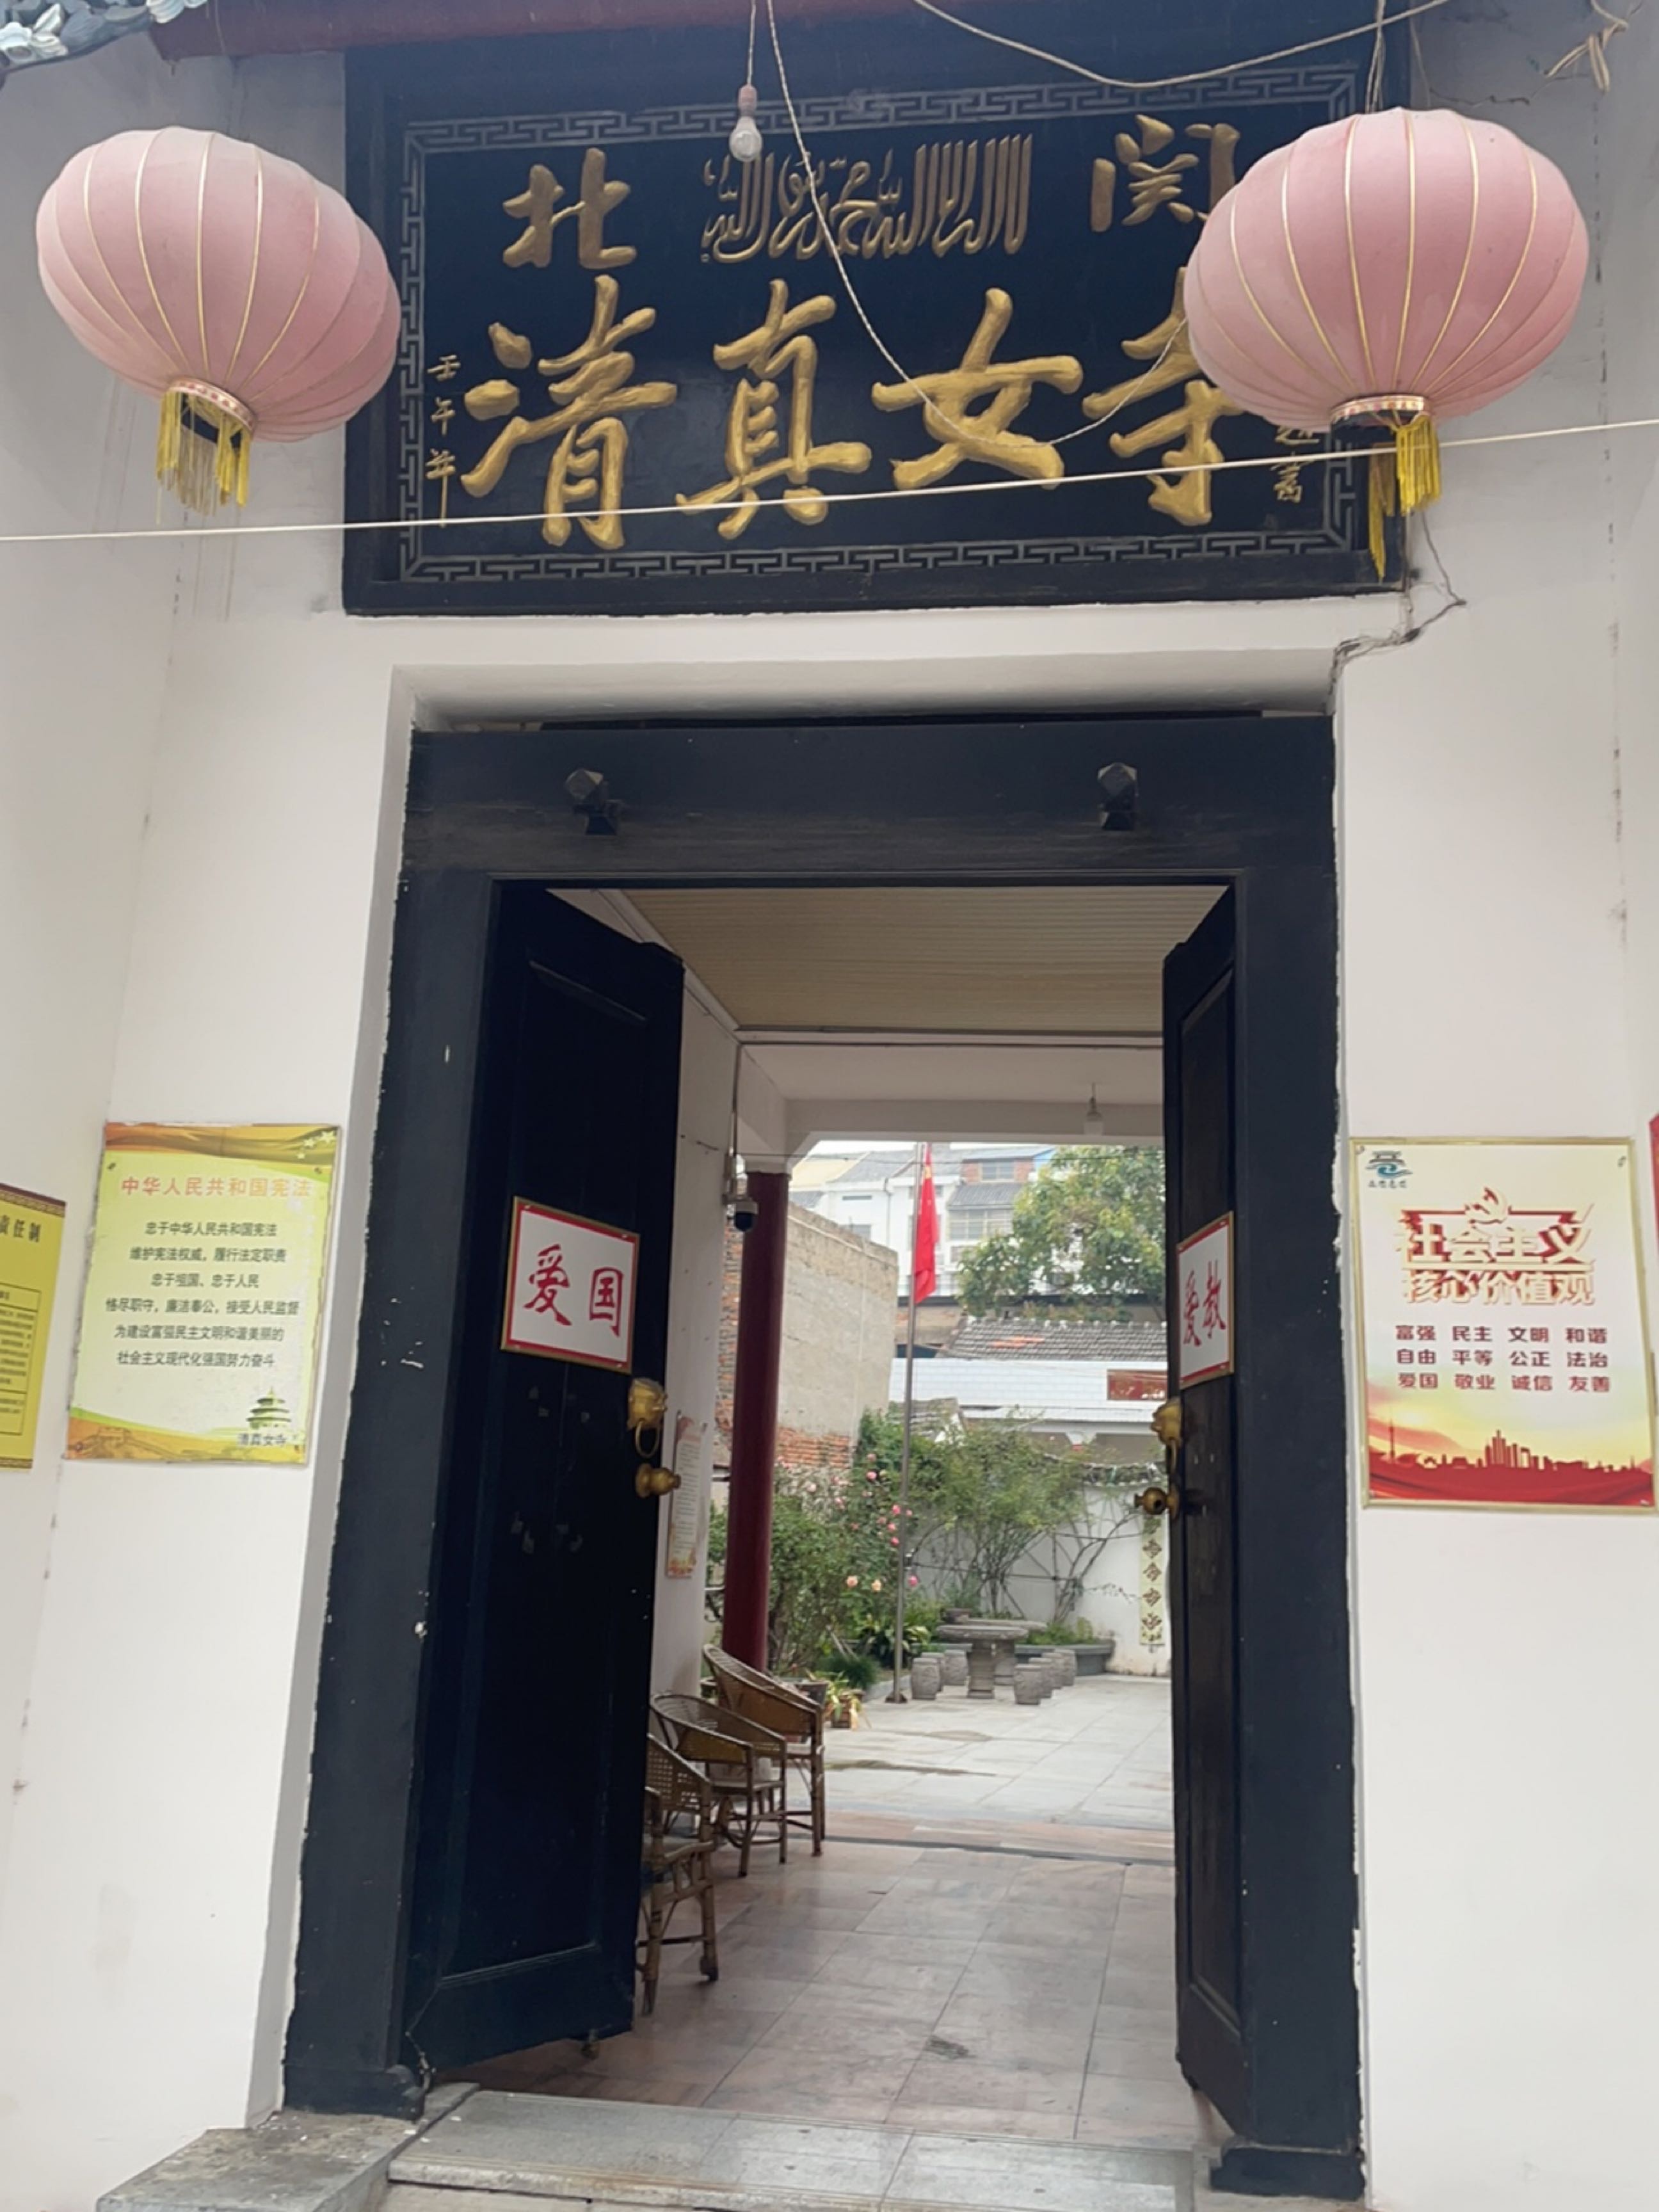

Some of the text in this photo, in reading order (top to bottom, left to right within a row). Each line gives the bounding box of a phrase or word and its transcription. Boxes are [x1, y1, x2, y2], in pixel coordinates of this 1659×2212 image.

[502, 147, 637, 269] 北
[460, 274, 1246, 550] 清真女寺
[121, 1176, 312, 1198] 中华人民共和国宪法
[145, 1221, 278, 1237] 忠于中华人民共和国宪法
[1393, 1205, 1594, 1267] 社会主义
[1402, 1270, 1596, 1306] 核心价值观
[1395, 1324, 1608, 1344] 富强 民主 文明 和谐
[1397, 1348, 1608, 1368] 自由 平等 公正 法治
[1399, 1372, 1610, 1393] 爱国 敬业 诚信 友善
